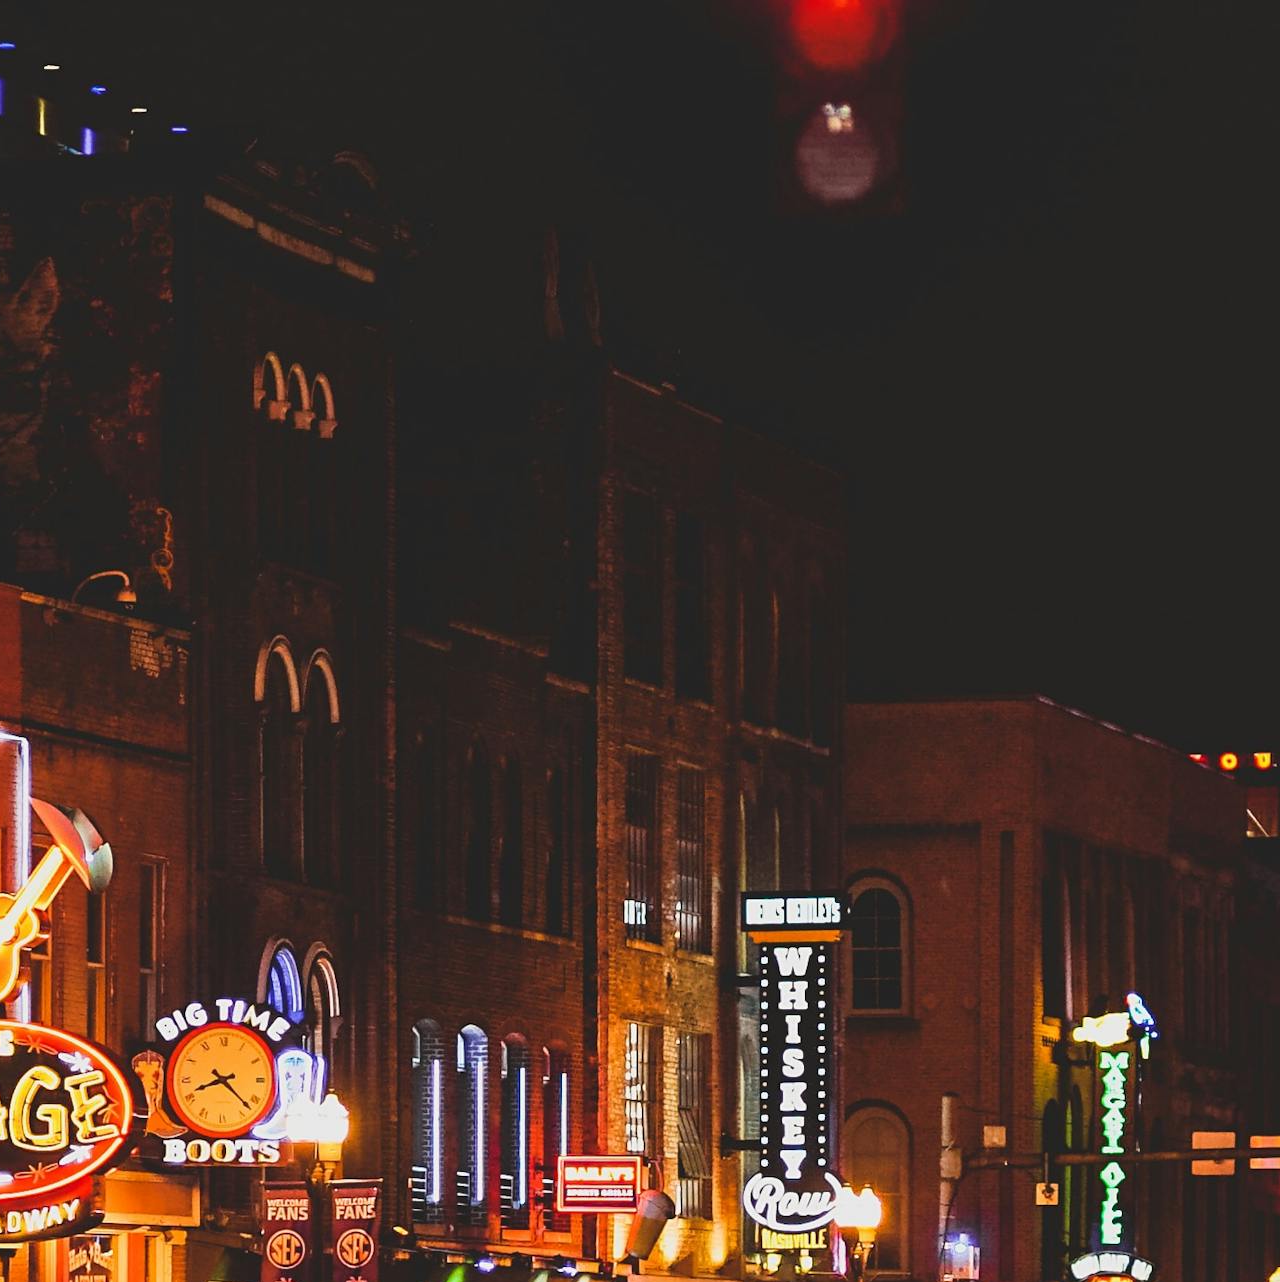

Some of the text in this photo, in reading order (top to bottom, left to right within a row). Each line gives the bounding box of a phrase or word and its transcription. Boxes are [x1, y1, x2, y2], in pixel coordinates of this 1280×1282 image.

[156, 999, 291, 1041] BIG TIME
[773, 947, 813, 1179] WHISKEY
[163, 1139, 280, 1163] BOOTS
[267, 1199, 309, 1207] WELCOME
[335, 1197, 376, 1205] WELCOME
[335, 1205, 376, 1219] FANS
[752, 1177, 833, 1223] Row
[267, 1207, 309, 1220] FANS
[271, 1234, 301, 1265] SEC
[341, 1232, 370, 1264] SEC
[761, 1228, 827, 1249] NASHVILLE
